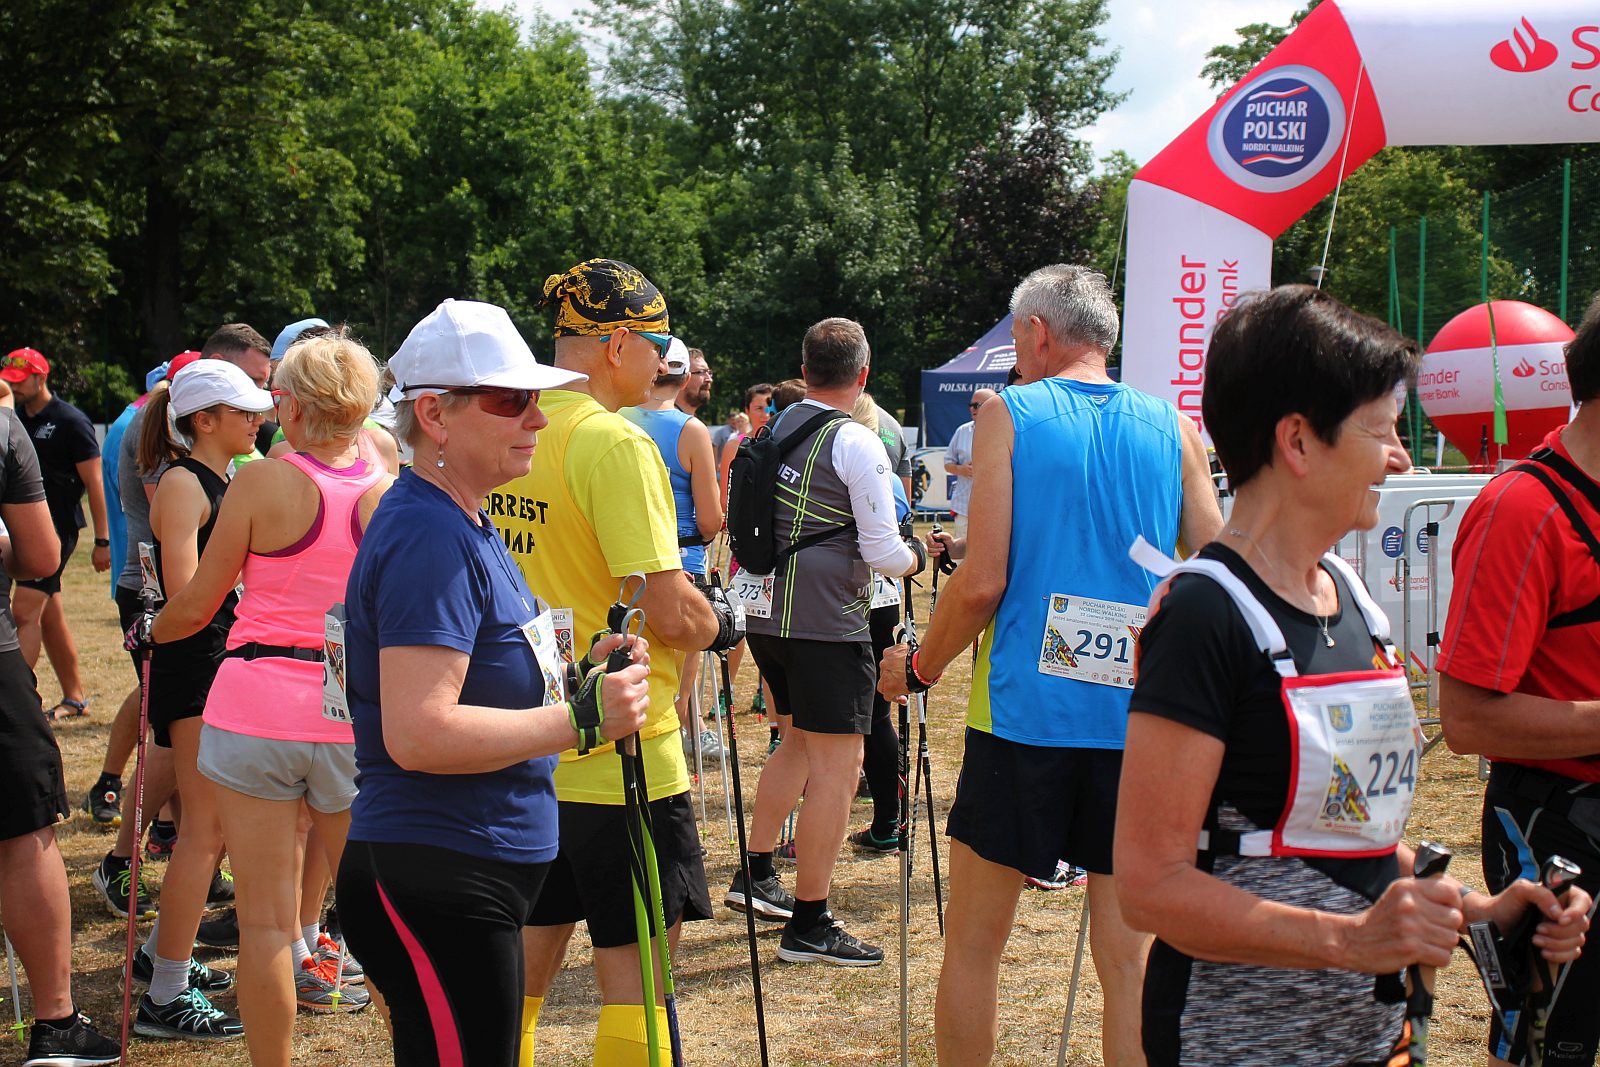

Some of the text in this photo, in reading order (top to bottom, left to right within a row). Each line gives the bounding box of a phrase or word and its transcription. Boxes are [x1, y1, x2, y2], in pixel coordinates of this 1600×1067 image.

[1246, 101, 1308, 118] PUCHAR
[1243, 121, 1307, 140] POLSKI
[1242, 143, 1304, 153] NORDIC WALKING
[939, 382, 973, 392] POLSKA
[739, 582, 763, 601] 273
[1074, 629, 1129, 664] 291
[1366, 749, 1415, 798] 224
